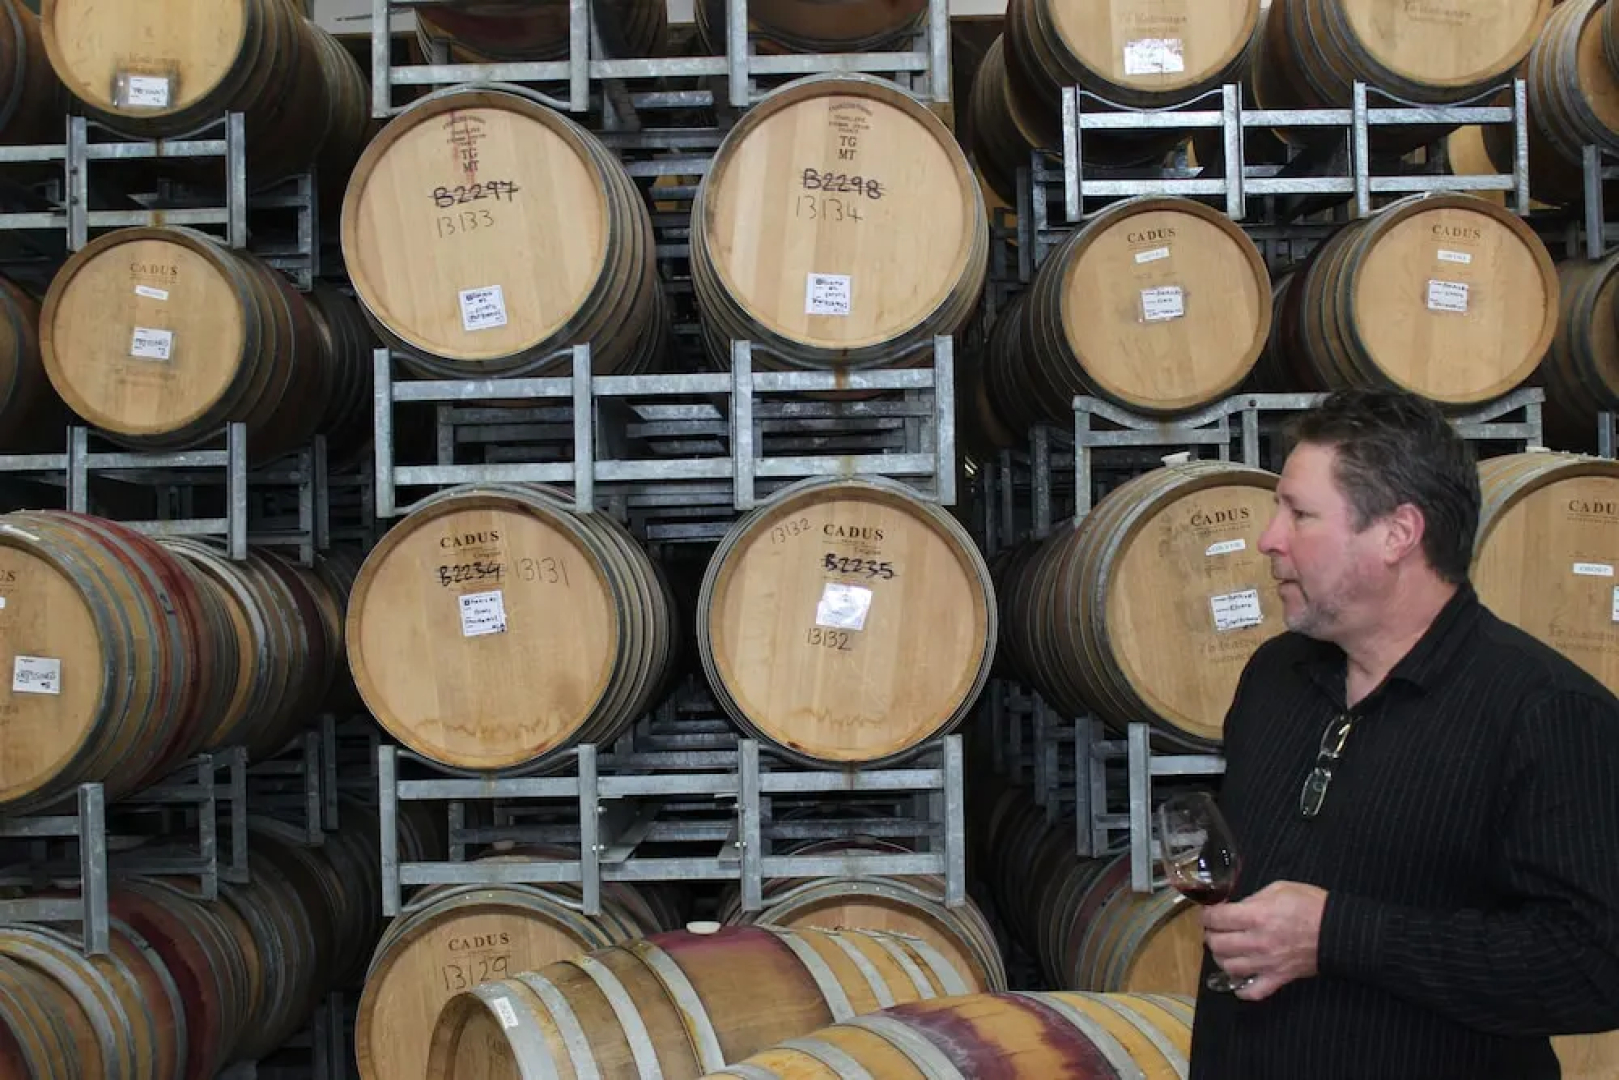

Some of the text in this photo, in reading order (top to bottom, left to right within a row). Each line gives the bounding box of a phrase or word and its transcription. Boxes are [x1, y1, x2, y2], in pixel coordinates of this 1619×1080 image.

[838, 135, 857, 148] TG
[838, 148, 857, 160] MT
[433, 180, 519, 208] B2297
[802, 167, 882, 200] B2298
[796, 195, 863, 223] 13134
[436, 208, 495, 239] 13133
[1432, 224, 1481, 239] CADUS
[1127, 228, 1176, 244] CADUS
[129, 262, 178, 276] CADUS
[1190, 507, 1249, 527] CADUS
[440, 530, 500, 548] CADUS
[770, 517, 811, 545] 13132
[823, 523, 884, 541] CADUS
[512, 556, 571, 588] 13131
[825, 553, 895, 580] B2235
[807, 627, 853, 652] 13132
[448, 932, 510, 952] CADUS
[442, 956, 509, 992] 13129
